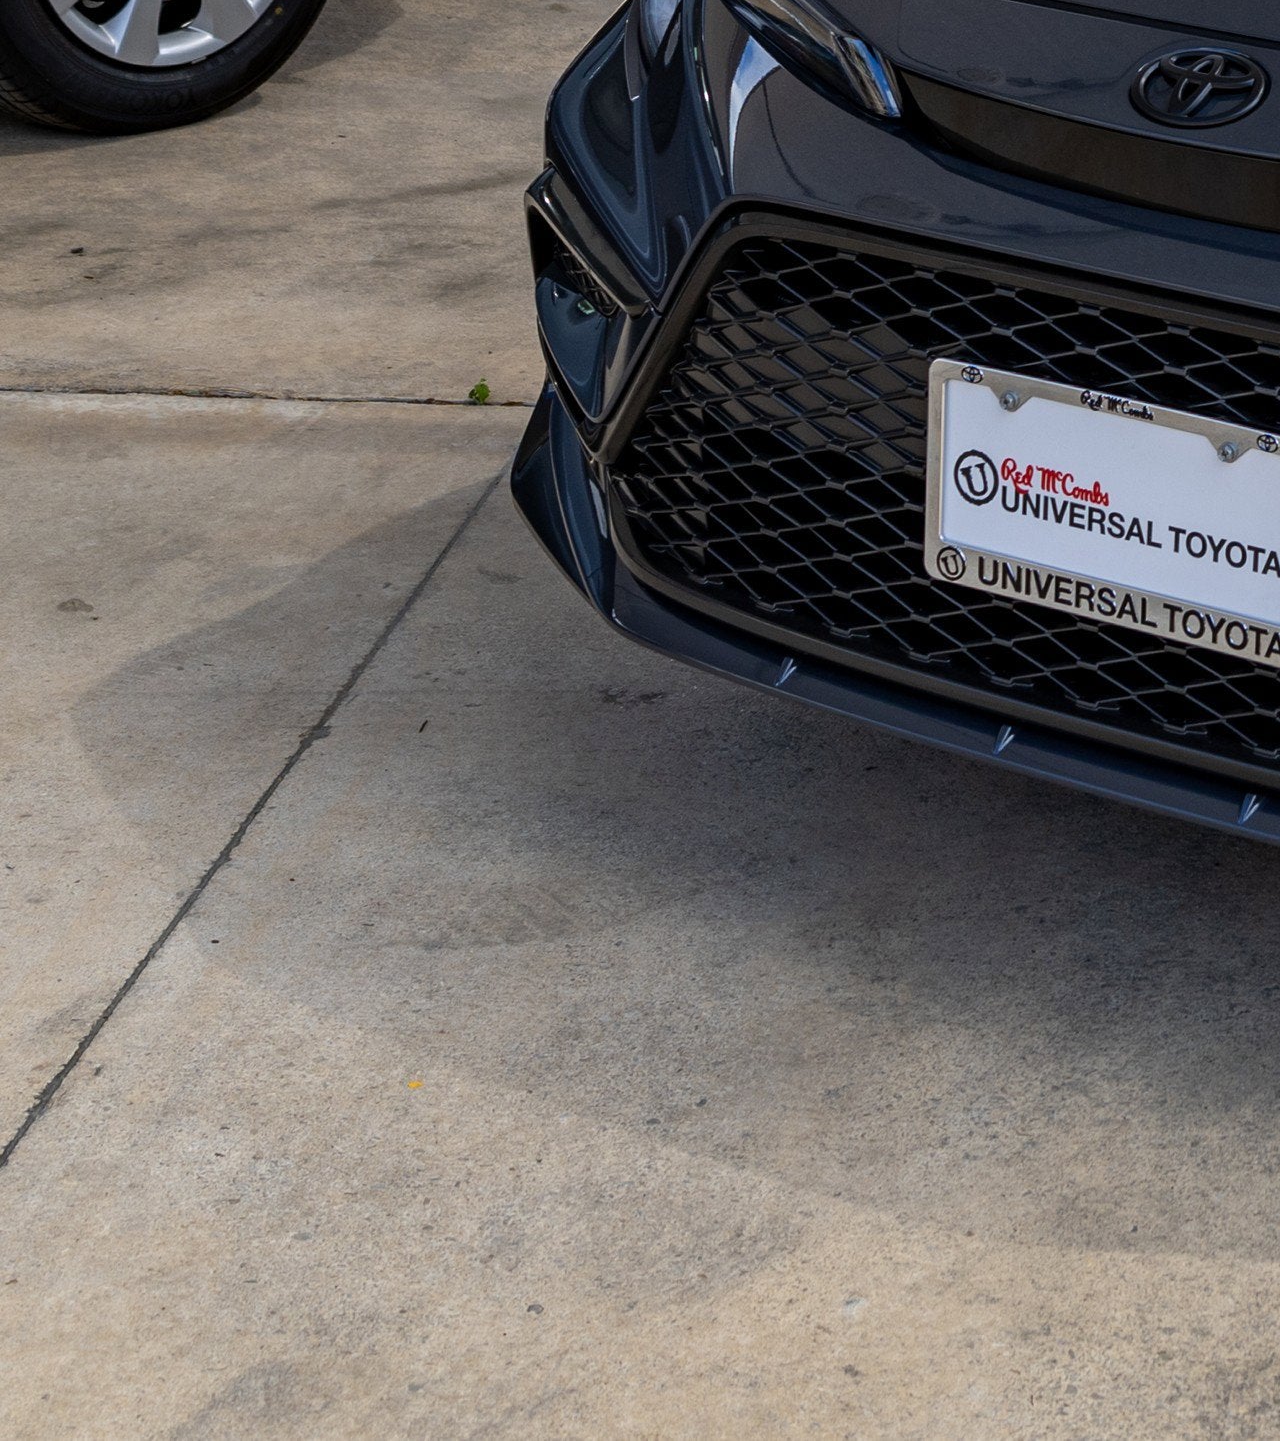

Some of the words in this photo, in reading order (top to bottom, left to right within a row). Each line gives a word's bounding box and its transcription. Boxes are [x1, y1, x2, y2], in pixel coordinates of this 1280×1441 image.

[1080, 389, 1103, 412] Red
[1107, 396, 1155, 422] McCombs
[1001, 457, 1035, 495] Red
[1036, 465, 1110, 507] McCombs
[1001, 485, 1163, 550] UNIVERSAL
[977, 555, 1158, 629] UNIVERSAL
